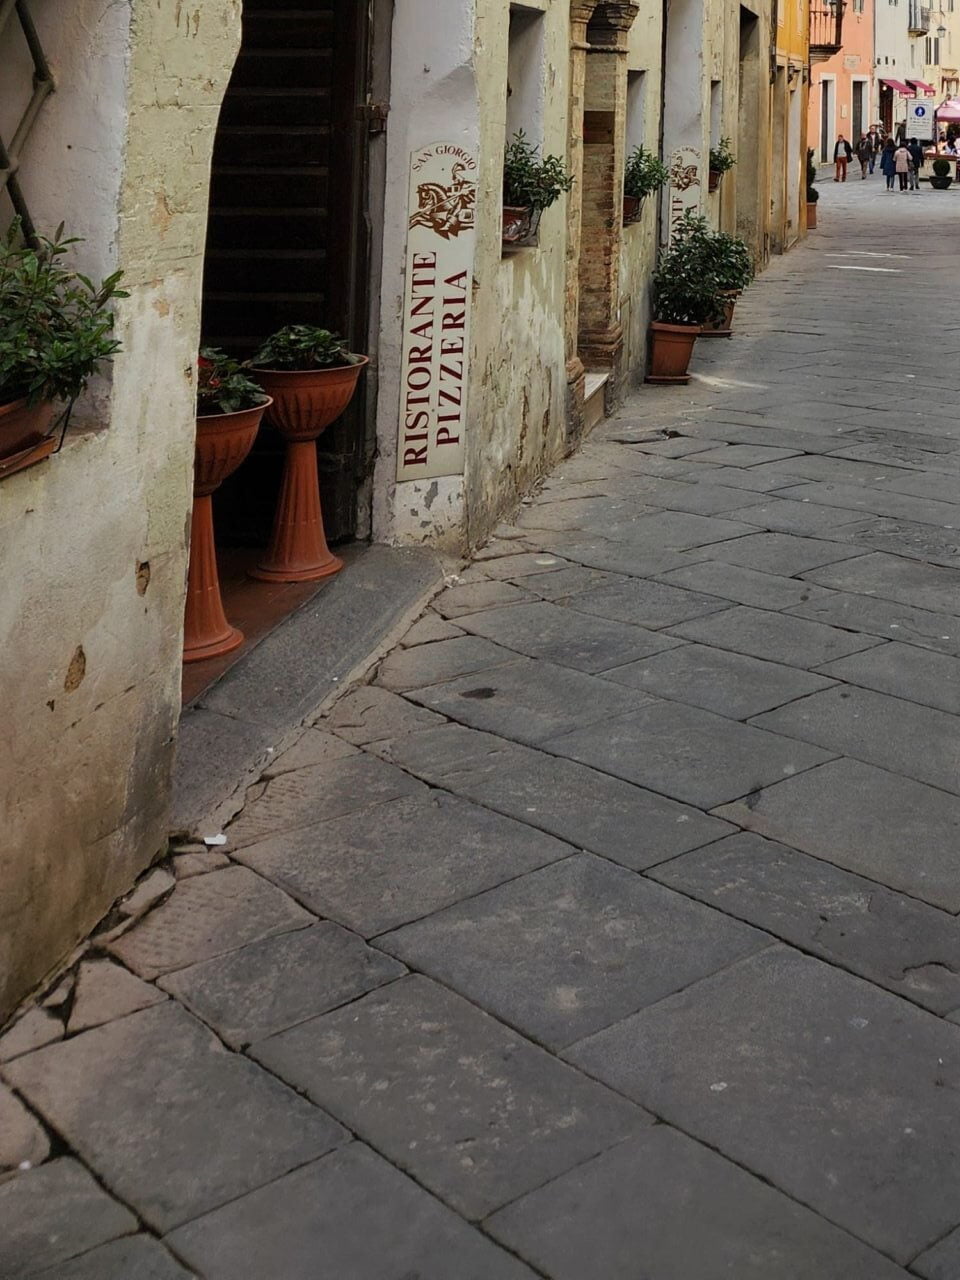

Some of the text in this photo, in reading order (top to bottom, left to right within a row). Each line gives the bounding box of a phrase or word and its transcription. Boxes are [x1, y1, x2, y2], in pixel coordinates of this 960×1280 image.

[412, 145, 477, 172] SAN GIORGIO
[403, 251, 437, 468] RISTORANTE
[436, 270, 467, 447] PIZZERIA
